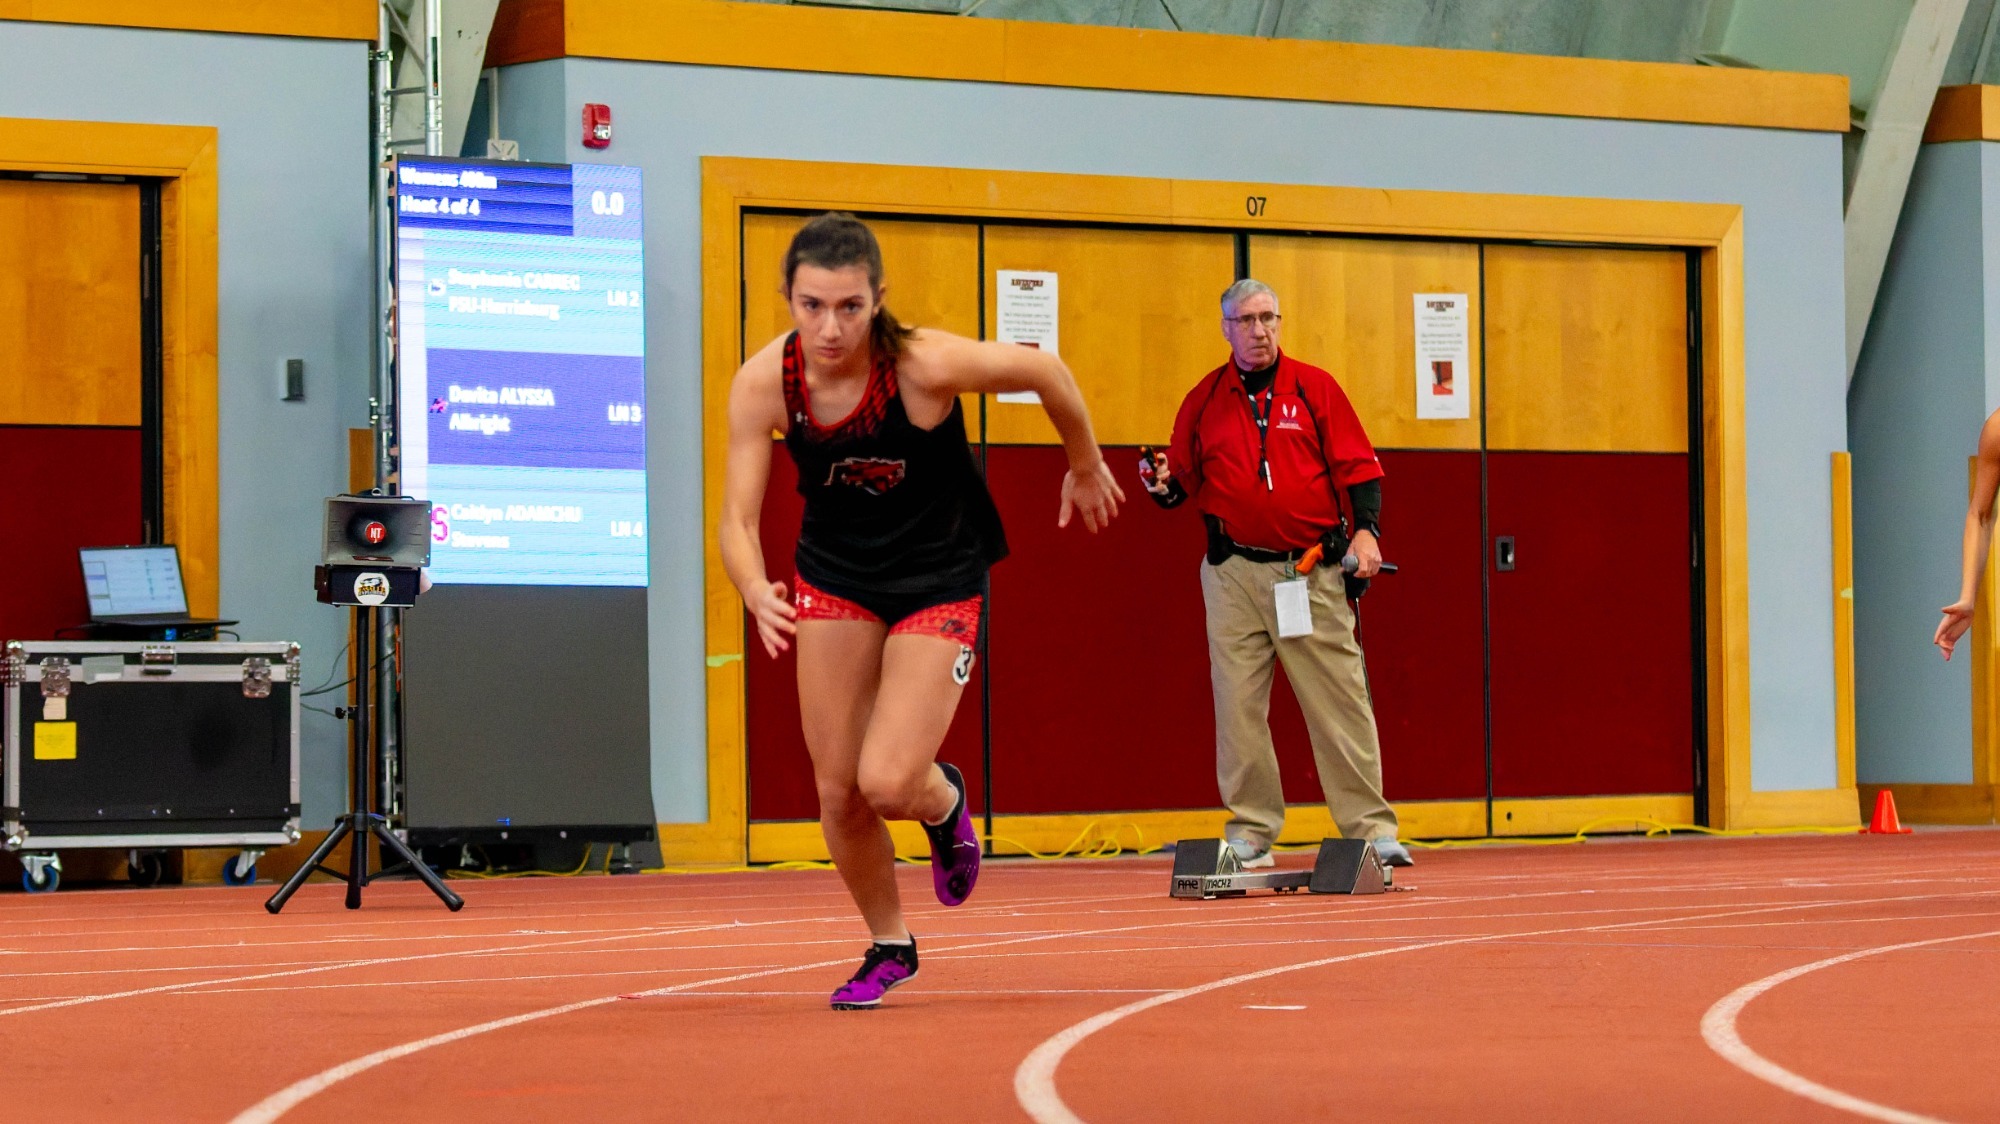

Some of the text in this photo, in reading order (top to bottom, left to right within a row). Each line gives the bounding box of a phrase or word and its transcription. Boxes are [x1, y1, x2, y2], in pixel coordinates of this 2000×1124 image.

[400, 195, 481, 216] Heat 4 of 4
[591, 190, 625, 216] 0.0
[1246, 196, 1267, 217] 07
[628, 290, 640, 308] 2
[499, 387, 555, 406] ALYSSA
[449, 412, 511, 435] Albright
[630, 405, 642, 422] 3
[632, 521, 644, 538] 4
[955, 649, 972, 681] 3
